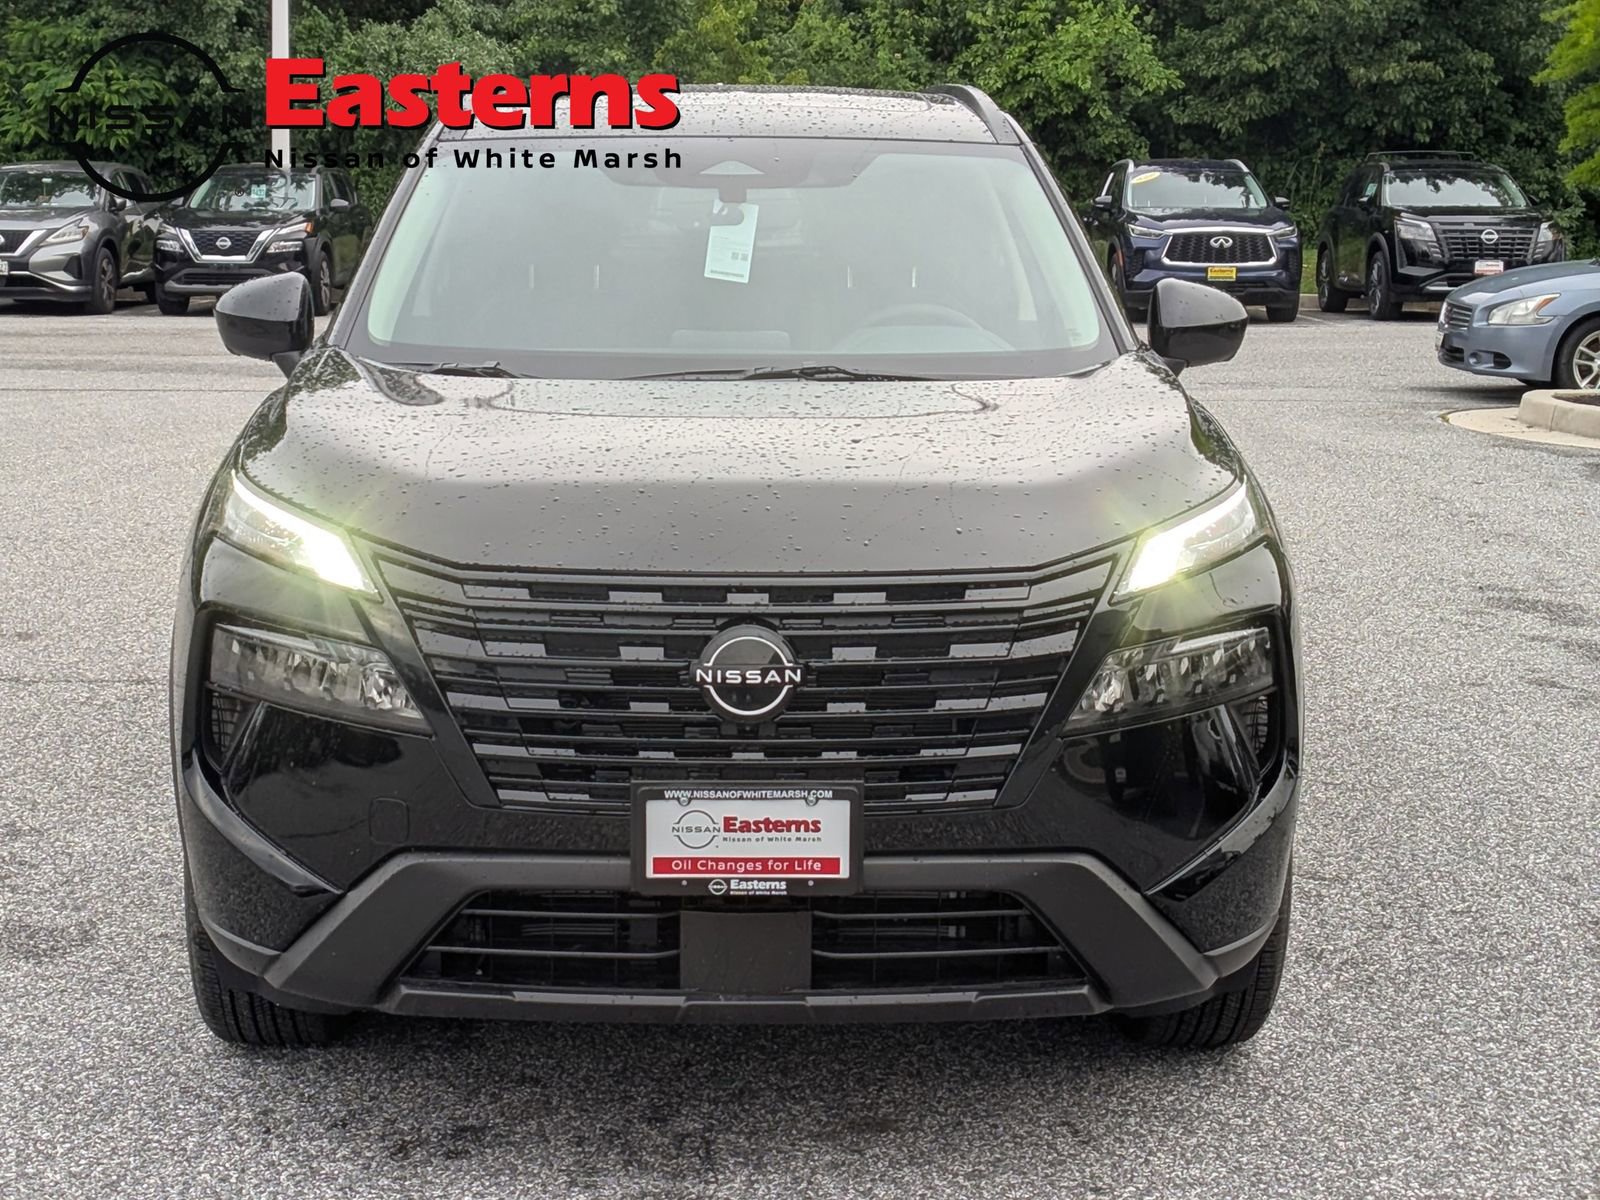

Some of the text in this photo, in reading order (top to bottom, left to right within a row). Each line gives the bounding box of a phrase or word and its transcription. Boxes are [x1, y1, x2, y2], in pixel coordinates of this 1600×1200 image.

[695, 669, 802, 684] NISSAN
[663, 789, 833, 799] WWW.NISSANOFWHITEMARSH.COM
[671, 825, 721, 833] NISSAN
[722, 816, 822, 834] Easterns
[671, 860, 822, 872] Oil Changes for Life
[730, 879, 787, 890] Easterns
